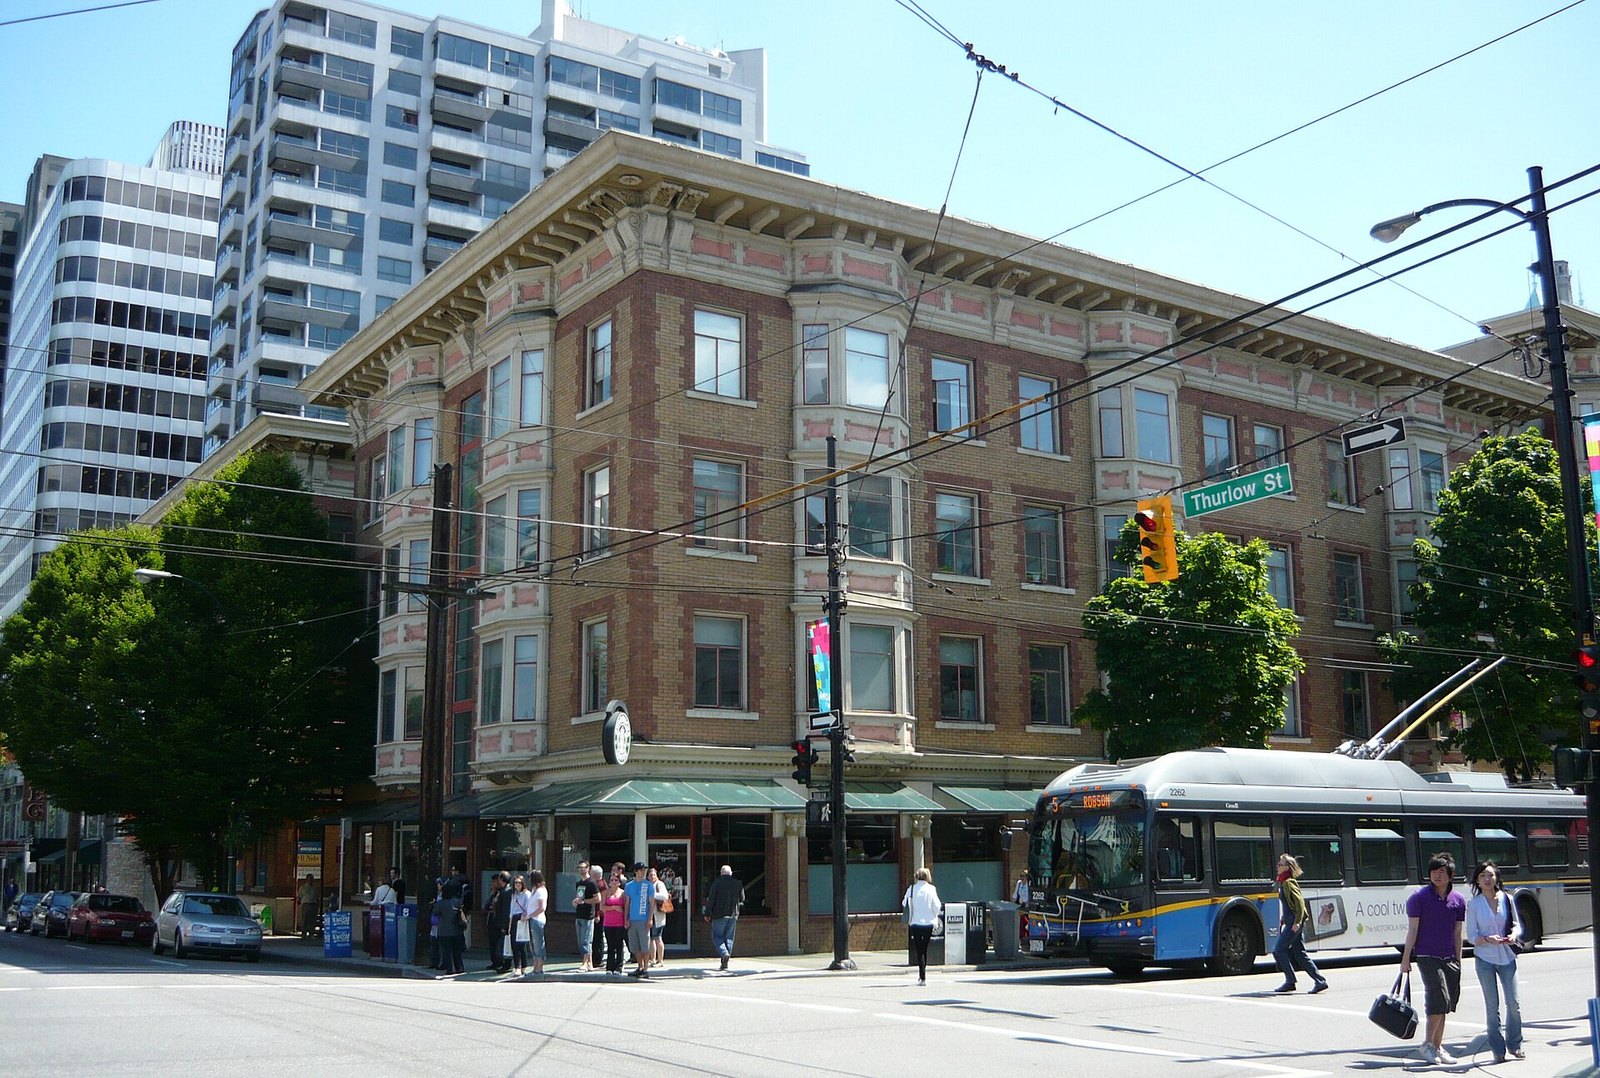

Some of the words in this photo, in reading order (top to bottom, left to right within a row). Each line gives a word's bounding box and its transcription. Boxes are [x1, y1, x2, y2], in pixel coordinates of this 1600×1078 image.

[1190, 482, 1256, 511] Thurlow
[1263, 472, 1284, 492] St
[1169, 787, 1186, 797] 2262
[1052, 796, 1059, 812] 5
[1083, 793, 1111, 808] ROBSON
[1355, 901, 1364, 917] A
[1367, 900, 1390, 917] cool
[1392, 900, 1407, 916] tw
